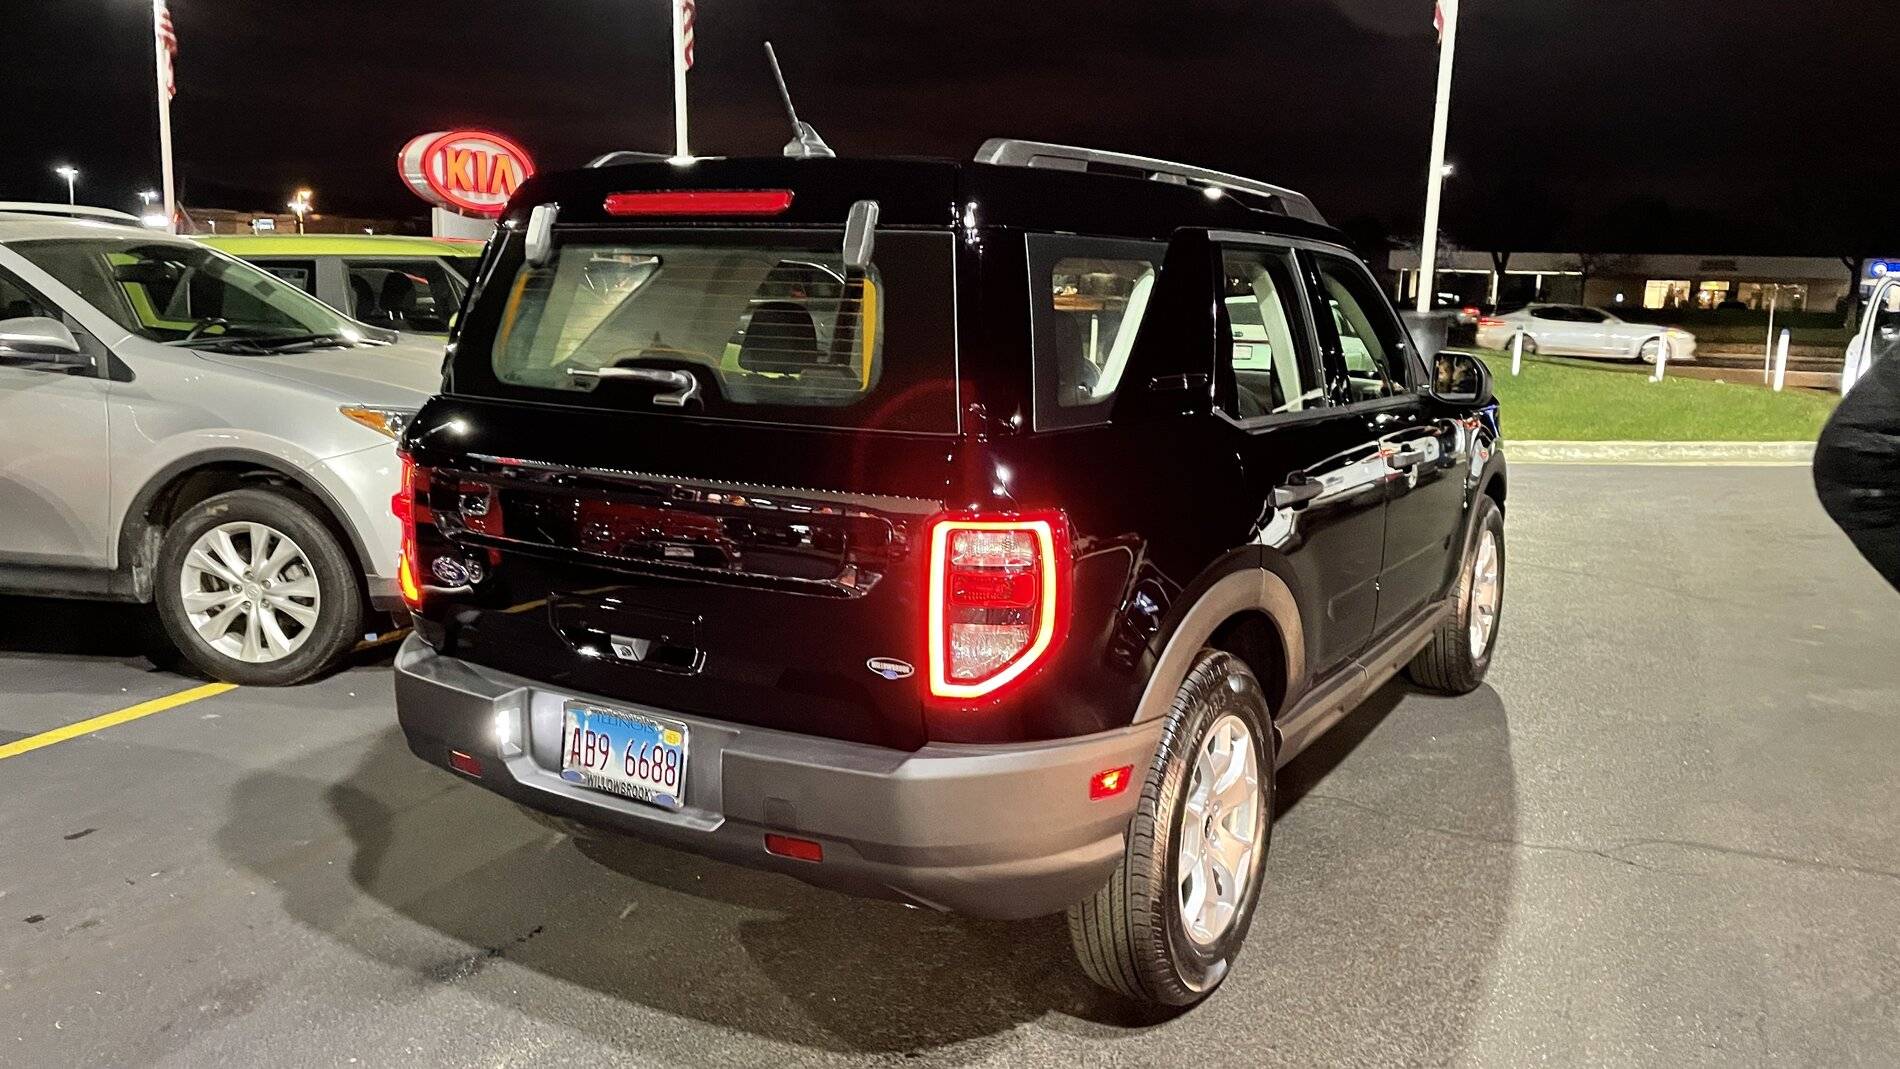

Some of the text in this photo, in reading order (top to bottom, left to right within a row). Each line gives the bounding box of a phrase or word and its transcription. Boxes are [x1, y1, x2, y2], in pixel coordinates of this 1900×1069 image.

[445, 147, 516, 196] KIA
[570, 727, 677, 787] AB9 6688
